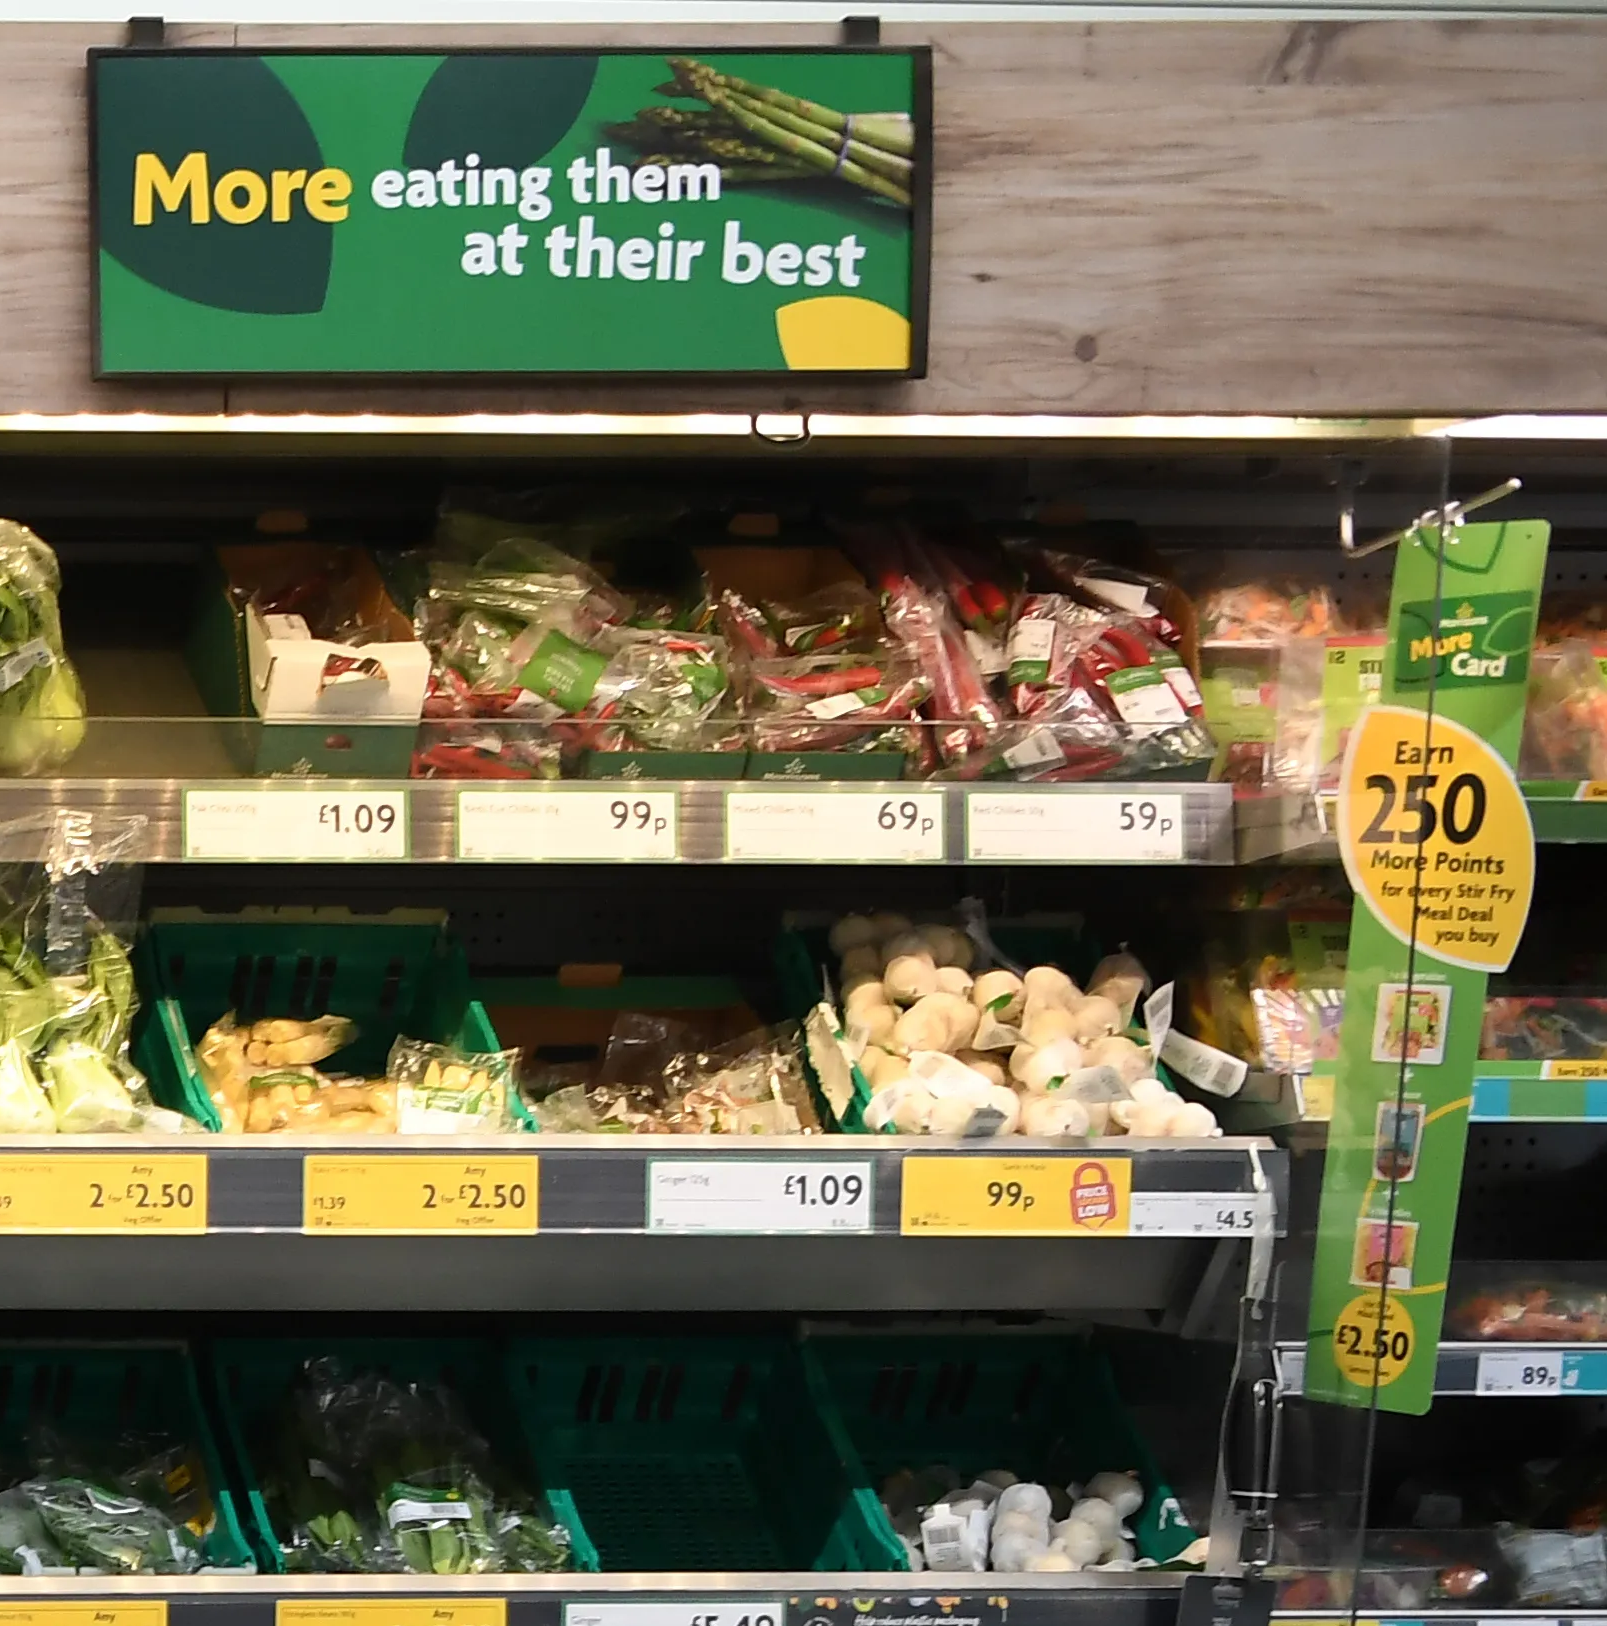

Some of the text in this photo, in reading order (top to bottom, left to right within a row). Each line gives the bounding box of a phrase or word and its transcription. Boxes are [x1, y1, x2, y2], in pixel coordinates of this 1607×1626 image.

[134, 148, 724, 225] More eating them
[461, 214, 866, 287] at their best
[1451, 652, 1507, 678] Card
[1394, 741, 1454, 766] Earn
[320, 805, 395, 833] £1.09
[611, 801, 666, 834] 99p
[878, 802, 933, 835] 69p
[1121, 802, 1172, 835] 59p
[1358, 772, 1487, 845] 250
[1371, 849, 1505, 876] More Points
[1381, 882, 1516, 904] for every Stir Fry
[1415, 905, 1494, 922] Meal Deal
[1434, 927, 1500, 946] you buy
[90, 1184, 193, 1208] 2 £2.50
[312, 1197, 347, 1209] £1.39
[423, 1184, 525, 1208] 2 £2.50
[785, 1175, 862, 1205] £1.09
[988, 1182, 1034, 1211] 99p
[1215, 1210, 1254, 1232] £4.5
[1336, 1323, 1410, 1363] £2.50
[1521, 1366, 1558, 1389] 89p
